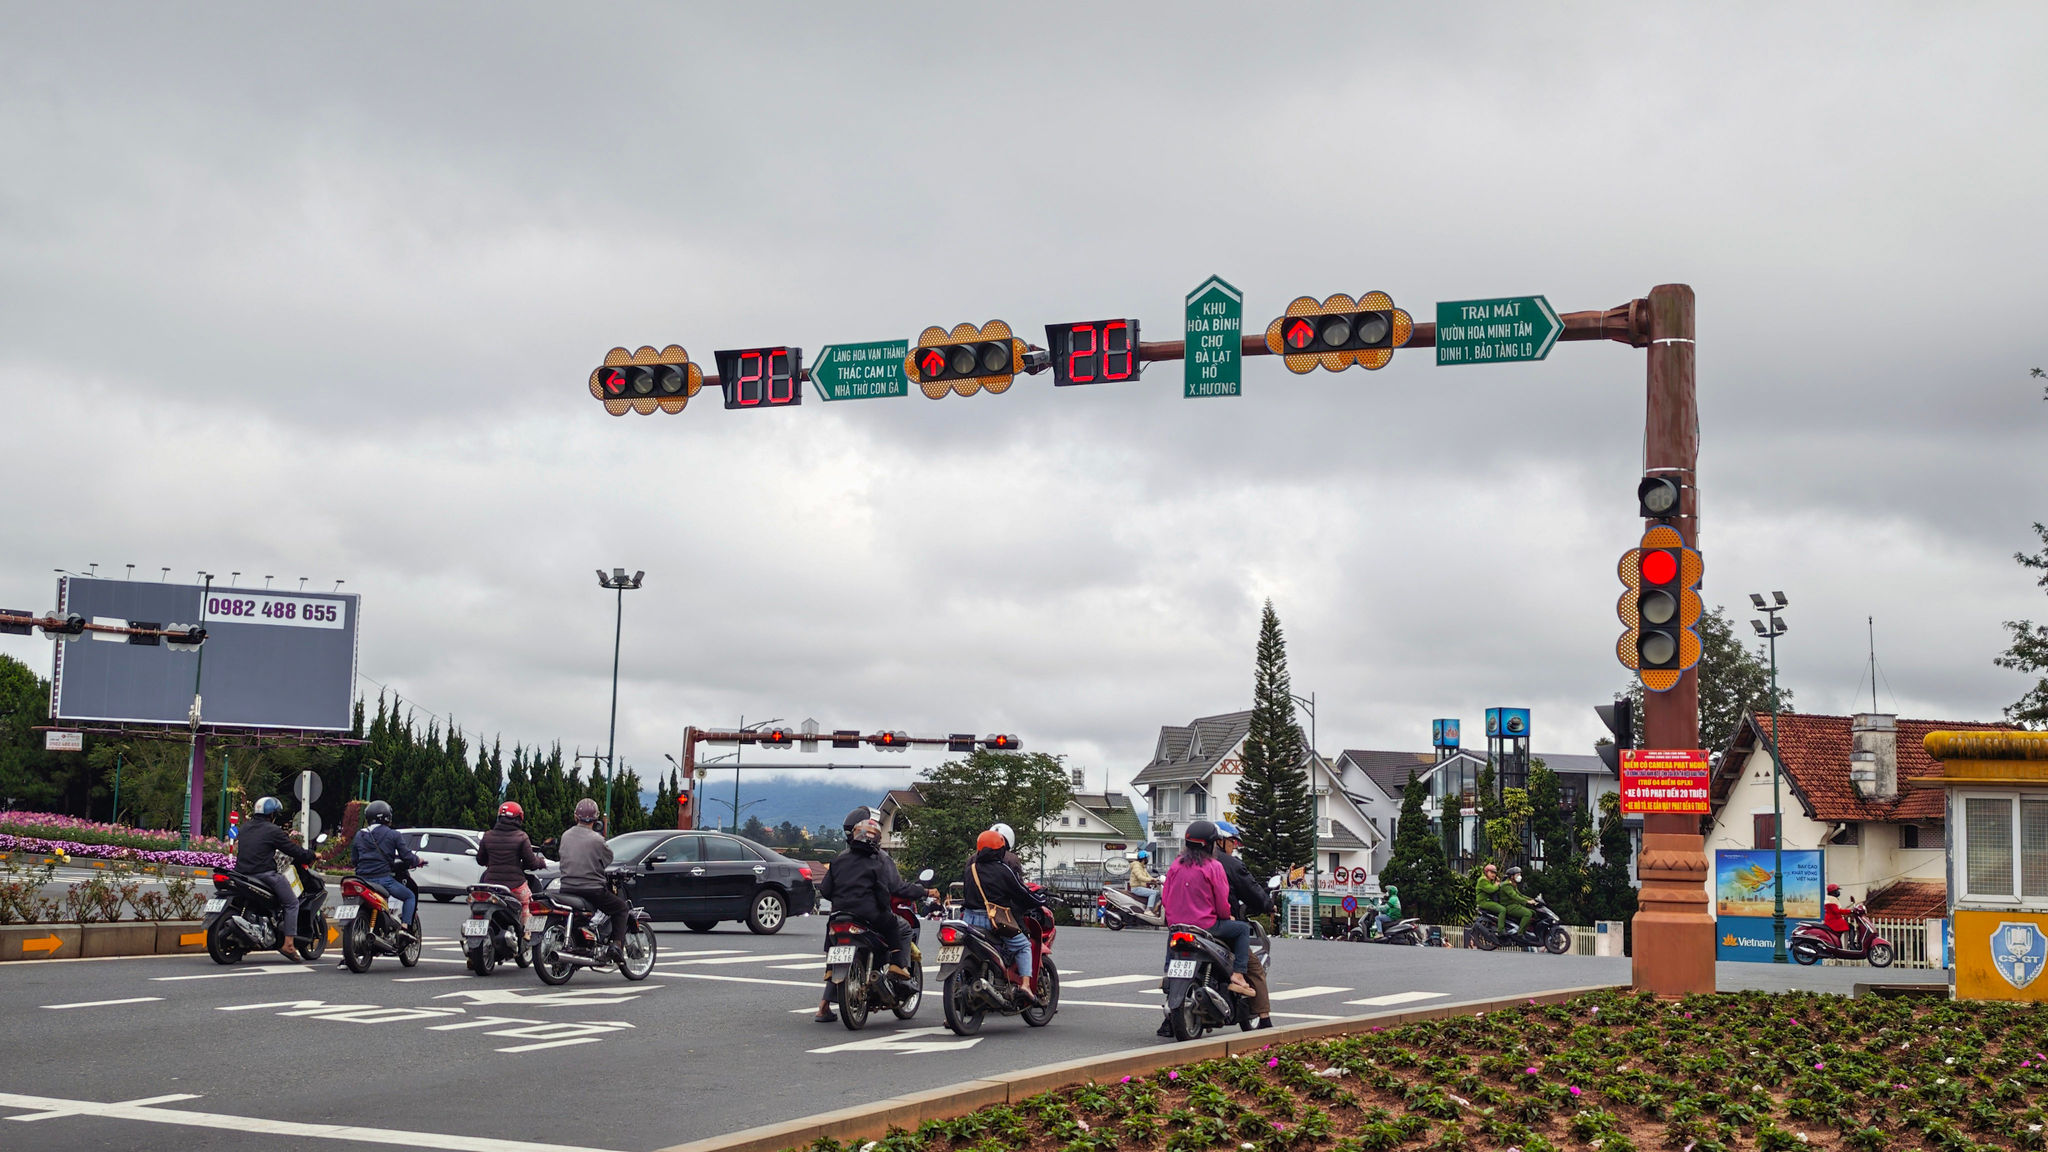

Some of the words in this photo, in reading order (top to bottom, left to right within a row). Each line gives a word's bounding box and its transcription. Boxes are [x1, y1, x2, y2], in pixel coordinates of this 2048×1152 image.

[1203, 302, 1226, 316] KHU
[1461, 305, 1490, 322] TRẠI
[1494, 300, 1520, 318] MÁT
[1188, 316, 1210, 332] HÒA
[1212, 315, 1240, 331] BÌNH
[1440, 324, 1465, 341] VƯỜN
[1468, 326, 1485, 340] HOA
[1488, 324, 1510, 338] MINH
[1513, 321, 1532, 337] TÂM
[1201, 335, 1224, 350] CHỢ
[1440, 346, 1462, 361] DINH
[1474, 342, 1492, 359] BẢO
[1494, 341, 1518, 358] TÀNG
[1520, 343, 1532, 356] LĐ
[833, 348, 851, 362] LÀNG
[852, 349, 866, 361] HOA
[868, 348, 882, 362] VẠN
[883, 345, 906, 359] THÀNH
[1068, 322, 1132, 382] 20
[1195, 348, 1210, 363] ĐÀ
[1212, 350, 1232, 364] LẠT
[737, 350, 794, 405] 20
[838, 363, 862, 380] THÁC
[864, 366, 884, 378] CAM
[887, 365, 898, 378] LY
[1202, 362, 1218, 378] HỒ
[834, 382, 850, 396] NHÀ
[852, 380, 868, 396] THỜ
[870, 382, 886, 394] CON
[888, 378, 899, 394] GÀ
[1190, 382, 1236, 396] X.HƯƠNG
[208, 598, 256, 617] 0982
[262, 601, 296, 620] 488
[302, 604, 337, 622] 655
[1637, 788, 1641, 797] Ô
[1642, 788, 1649, 797] TÔ
[1651, 789, 1666, 799] PHẠT
[1680, 790, 1688, 798] 20
